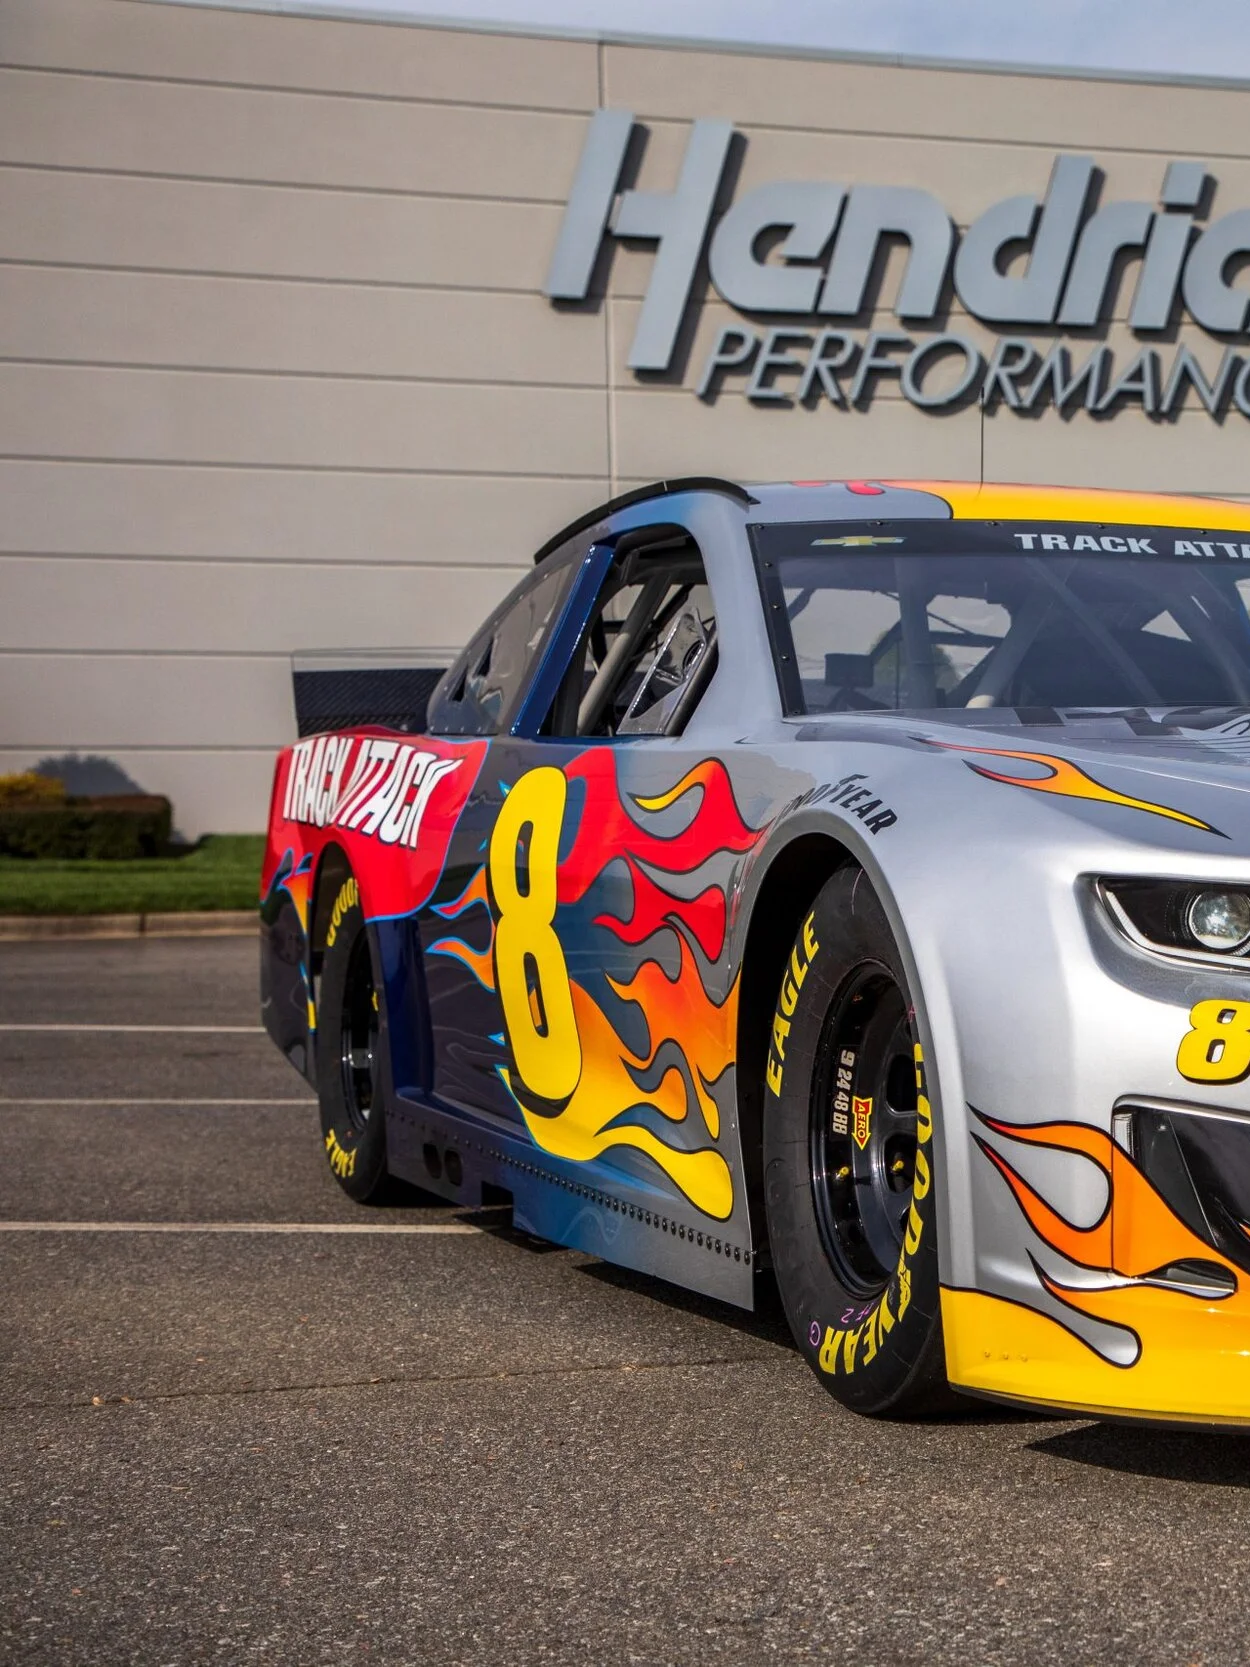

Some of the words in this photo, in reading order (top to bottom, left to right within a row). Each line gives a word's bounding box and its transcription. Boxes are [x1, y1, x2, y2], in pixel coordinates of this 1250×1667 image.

[1014, 533, 1158, 554] TRACK
[283, 736, 355, 828] TRACK
[330, 736, 466, 850] ATTACK
[487, 766, 582, 1112] 8
[766, 910, 820, 1098] EAGLE
[841, 1049, 856, 1067] 9
[836, 1067, 853, 1091] 24
[834, 1091, 850, 1111] 48
[832, 1111, 848, 1135] 88
[857, 1103, 866, 1138] AERO
